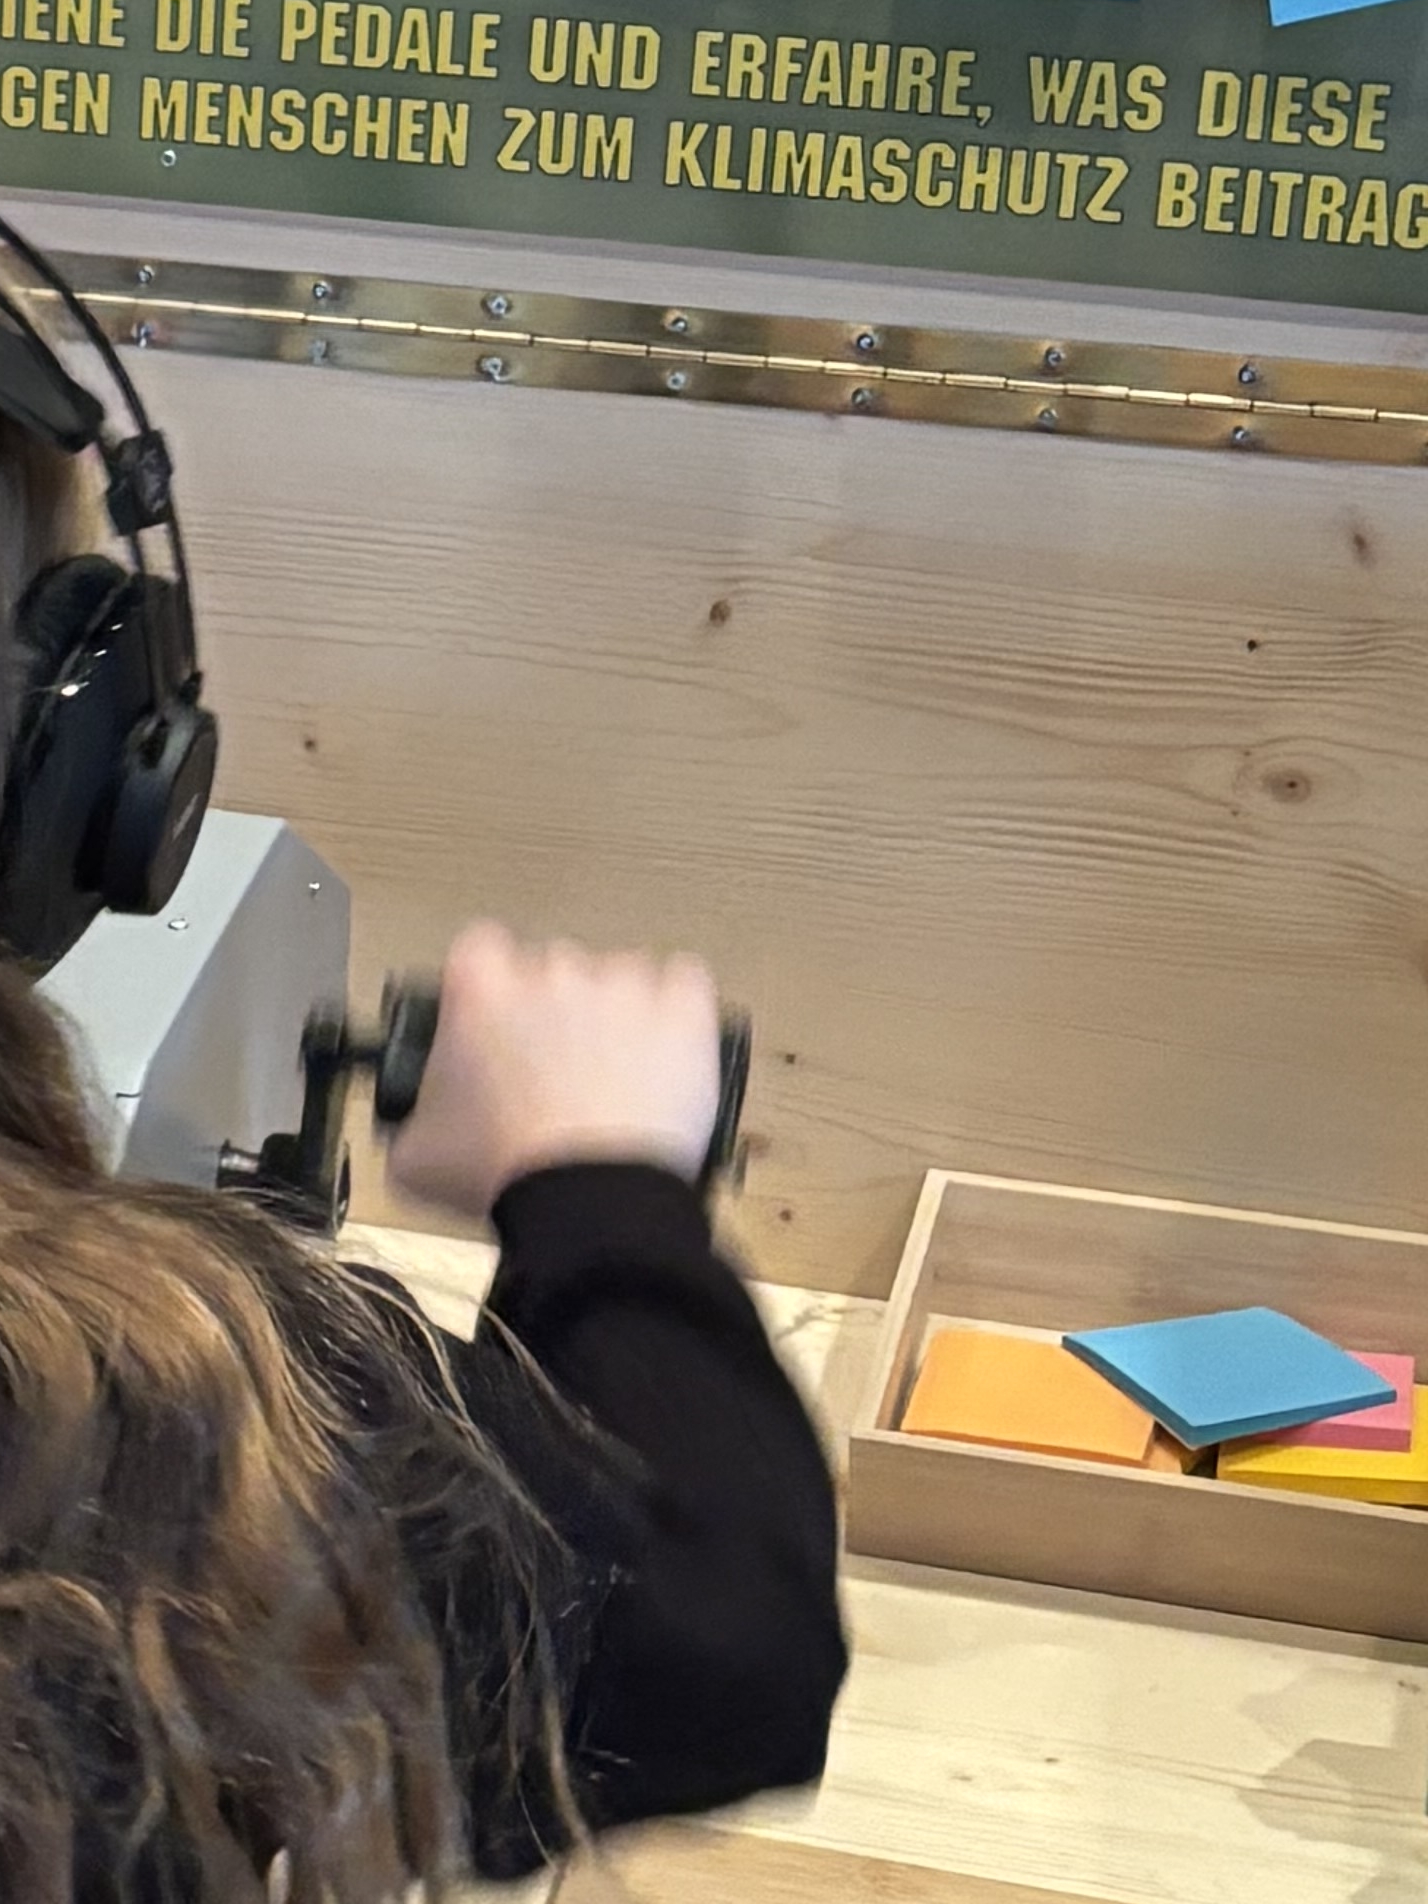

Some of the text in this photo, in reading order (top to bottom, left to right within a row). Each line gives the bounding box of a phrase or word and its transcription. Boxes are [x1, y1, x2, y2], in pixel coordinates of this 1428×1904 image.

[140, 75, 471, 169] MENSCHEN
[495, 107, 634, 182] ZUM
[664, 118, 1131, 224] KLIMASCHUTZ
[1155, 160, 1428, 250] BEITRAG
[527, 16, 661, 92] UND
[691, 28, 994, 128] ERFAHRE,
[1028, 54, 1168, 133] WAS
[1196, 68, 1393, 153] DIESE
